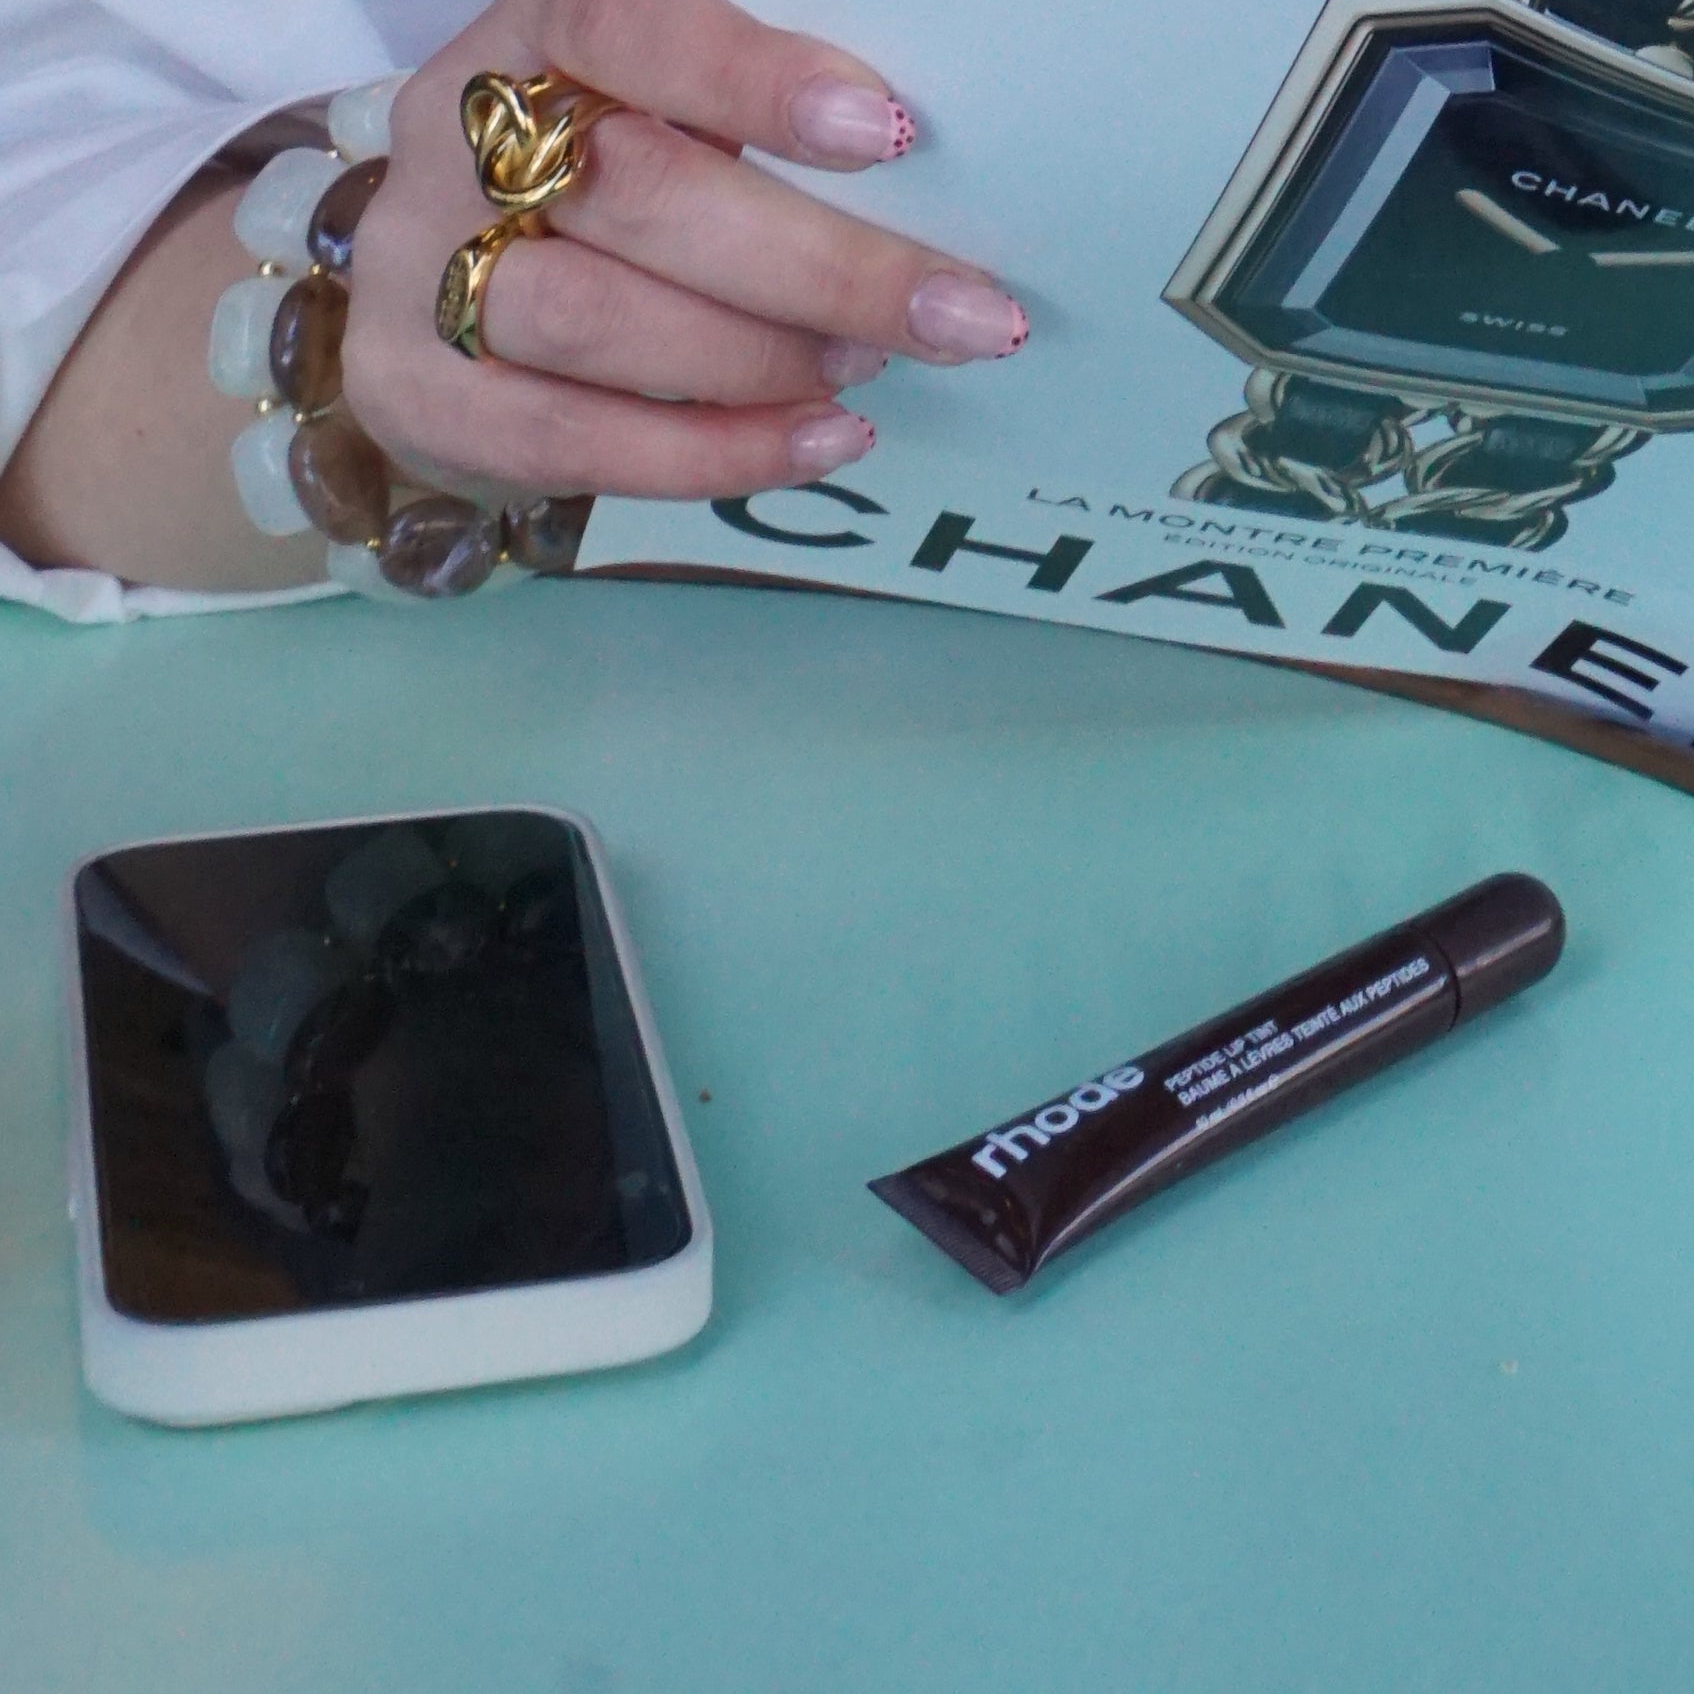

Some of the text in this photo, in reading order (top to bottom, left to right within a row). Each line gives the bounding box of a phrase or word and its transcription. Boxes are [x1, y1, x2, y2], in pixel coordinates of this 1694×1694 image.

[1460, 311, 1568, 336] SWISS
[1026, 486, 1635, 606] LA MONTRE PREMIÈRE
[1164, 1019, 1279, 1092] PEPTIDE LIP TINT
[1177, 1068, 1231, 1107] BAUME
[1339, 989, 1369, 1017] AUX
[1365, 956, 1431, 1002] PEPTIDES
[971, 1066, 1145, 1179] rhode
